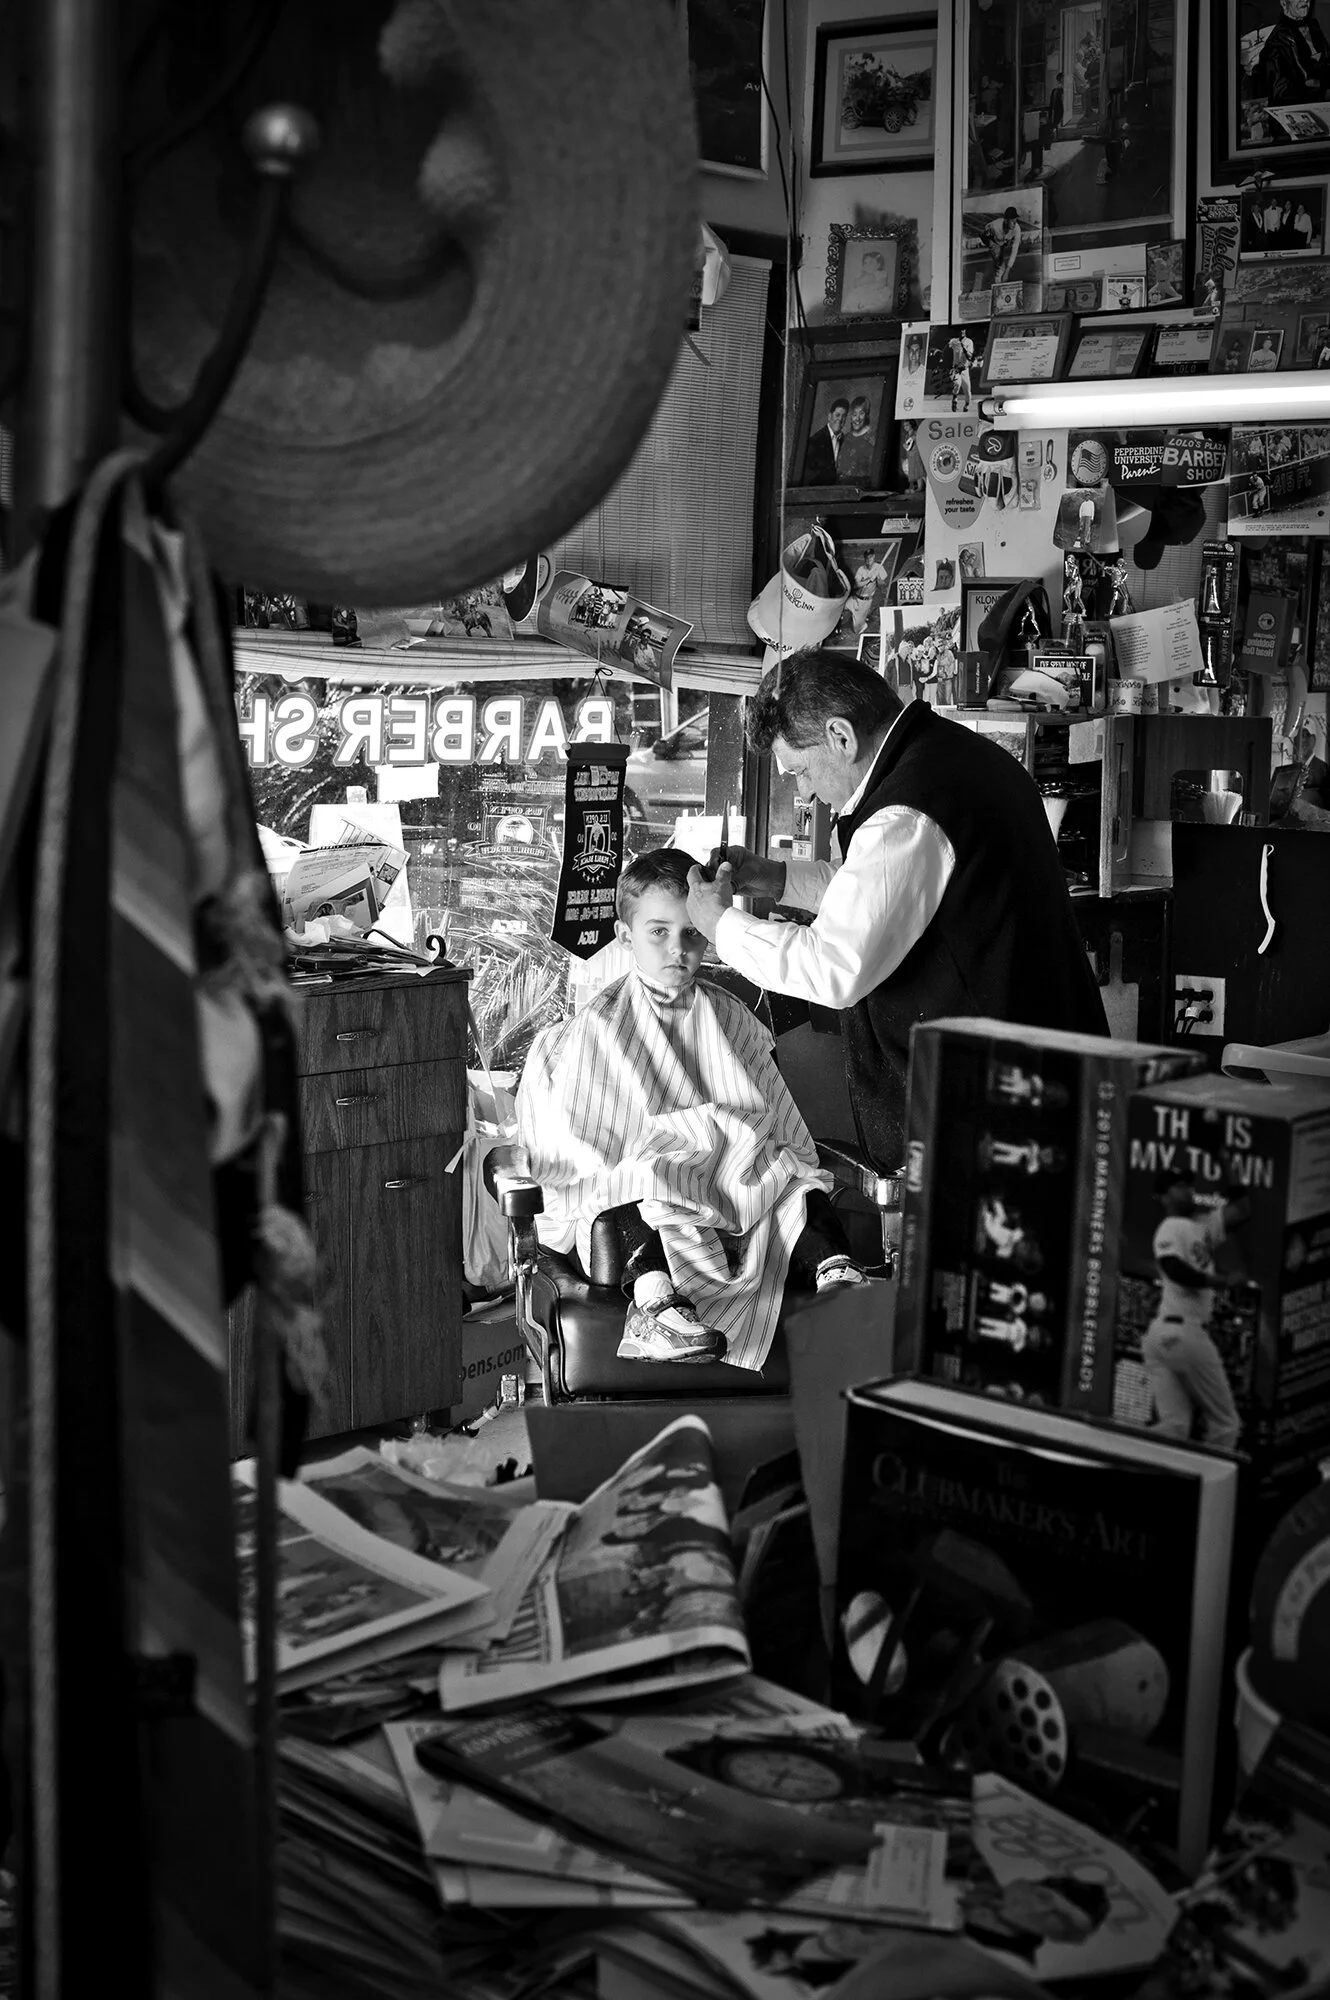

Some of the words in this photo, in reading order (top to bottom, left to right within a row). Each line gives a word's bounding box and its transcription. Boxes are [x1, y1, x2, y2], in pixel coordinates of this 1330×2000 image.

[928, 420, 974, 440] Sale
[1168, 438, 1202, 449] LOLO'S
[1114, 446, 1165, 457] PEPPERDINE
[1114, 455, 1164, 465] UNIVERSITY
[1121, 464, 1160, 480] Parent
[945, 498, 974, 506] refreshes
[944, 507, 958, 515] your
[959, 505, 976, 513] taste
[1096, 1108, 1112, 1156] 2010
[1130, 1138, 1176, 1172] MY
[1089, 1157, 1110, 1255] MARINERS
